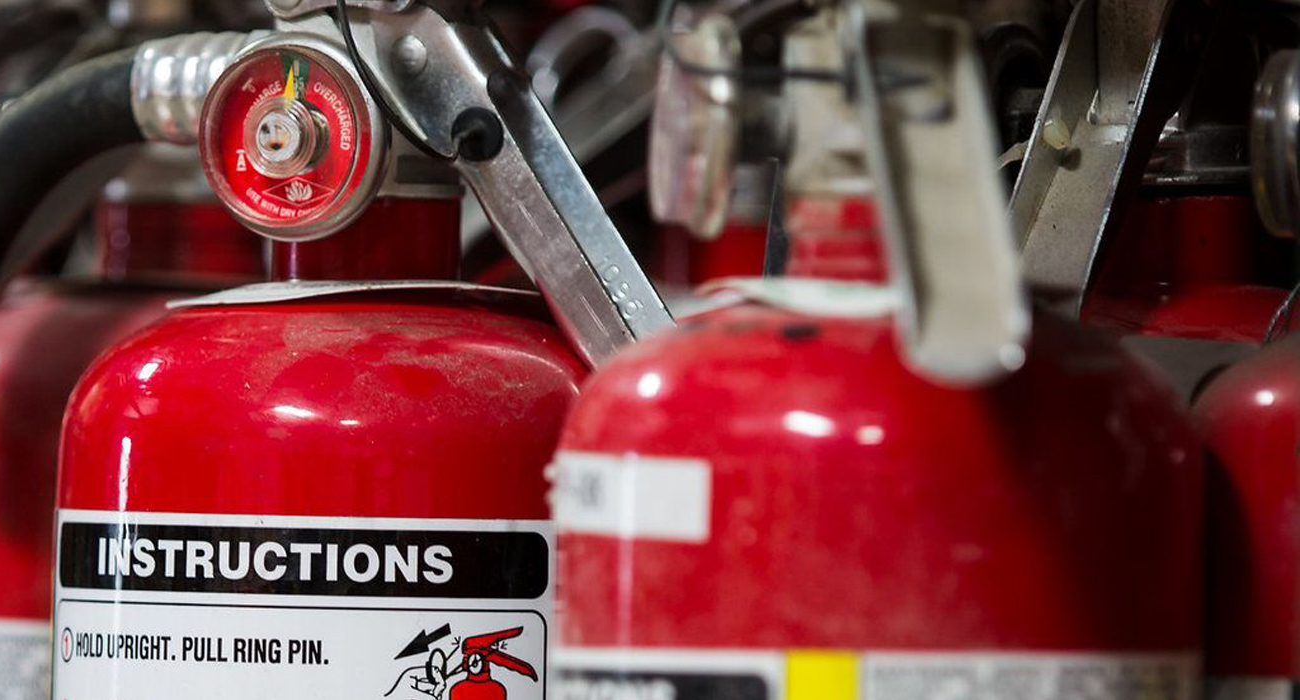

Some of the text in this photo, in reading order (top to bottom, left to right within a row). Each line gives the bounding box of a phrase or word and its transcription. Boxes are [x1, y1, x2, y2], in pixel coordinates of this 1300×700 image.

[313, 81, 352, 150] OVERCHARGED
[97, 536, 455, 584] INSTRUCTIONS
[75, 633, 104, 657] HOLD
[107, 634, 176, 660] UPRIGHT.
[182, 636, 228, 662] PULL
[233, 638, 281, 663] RING
[288, 639, 330, 665] PIN.
